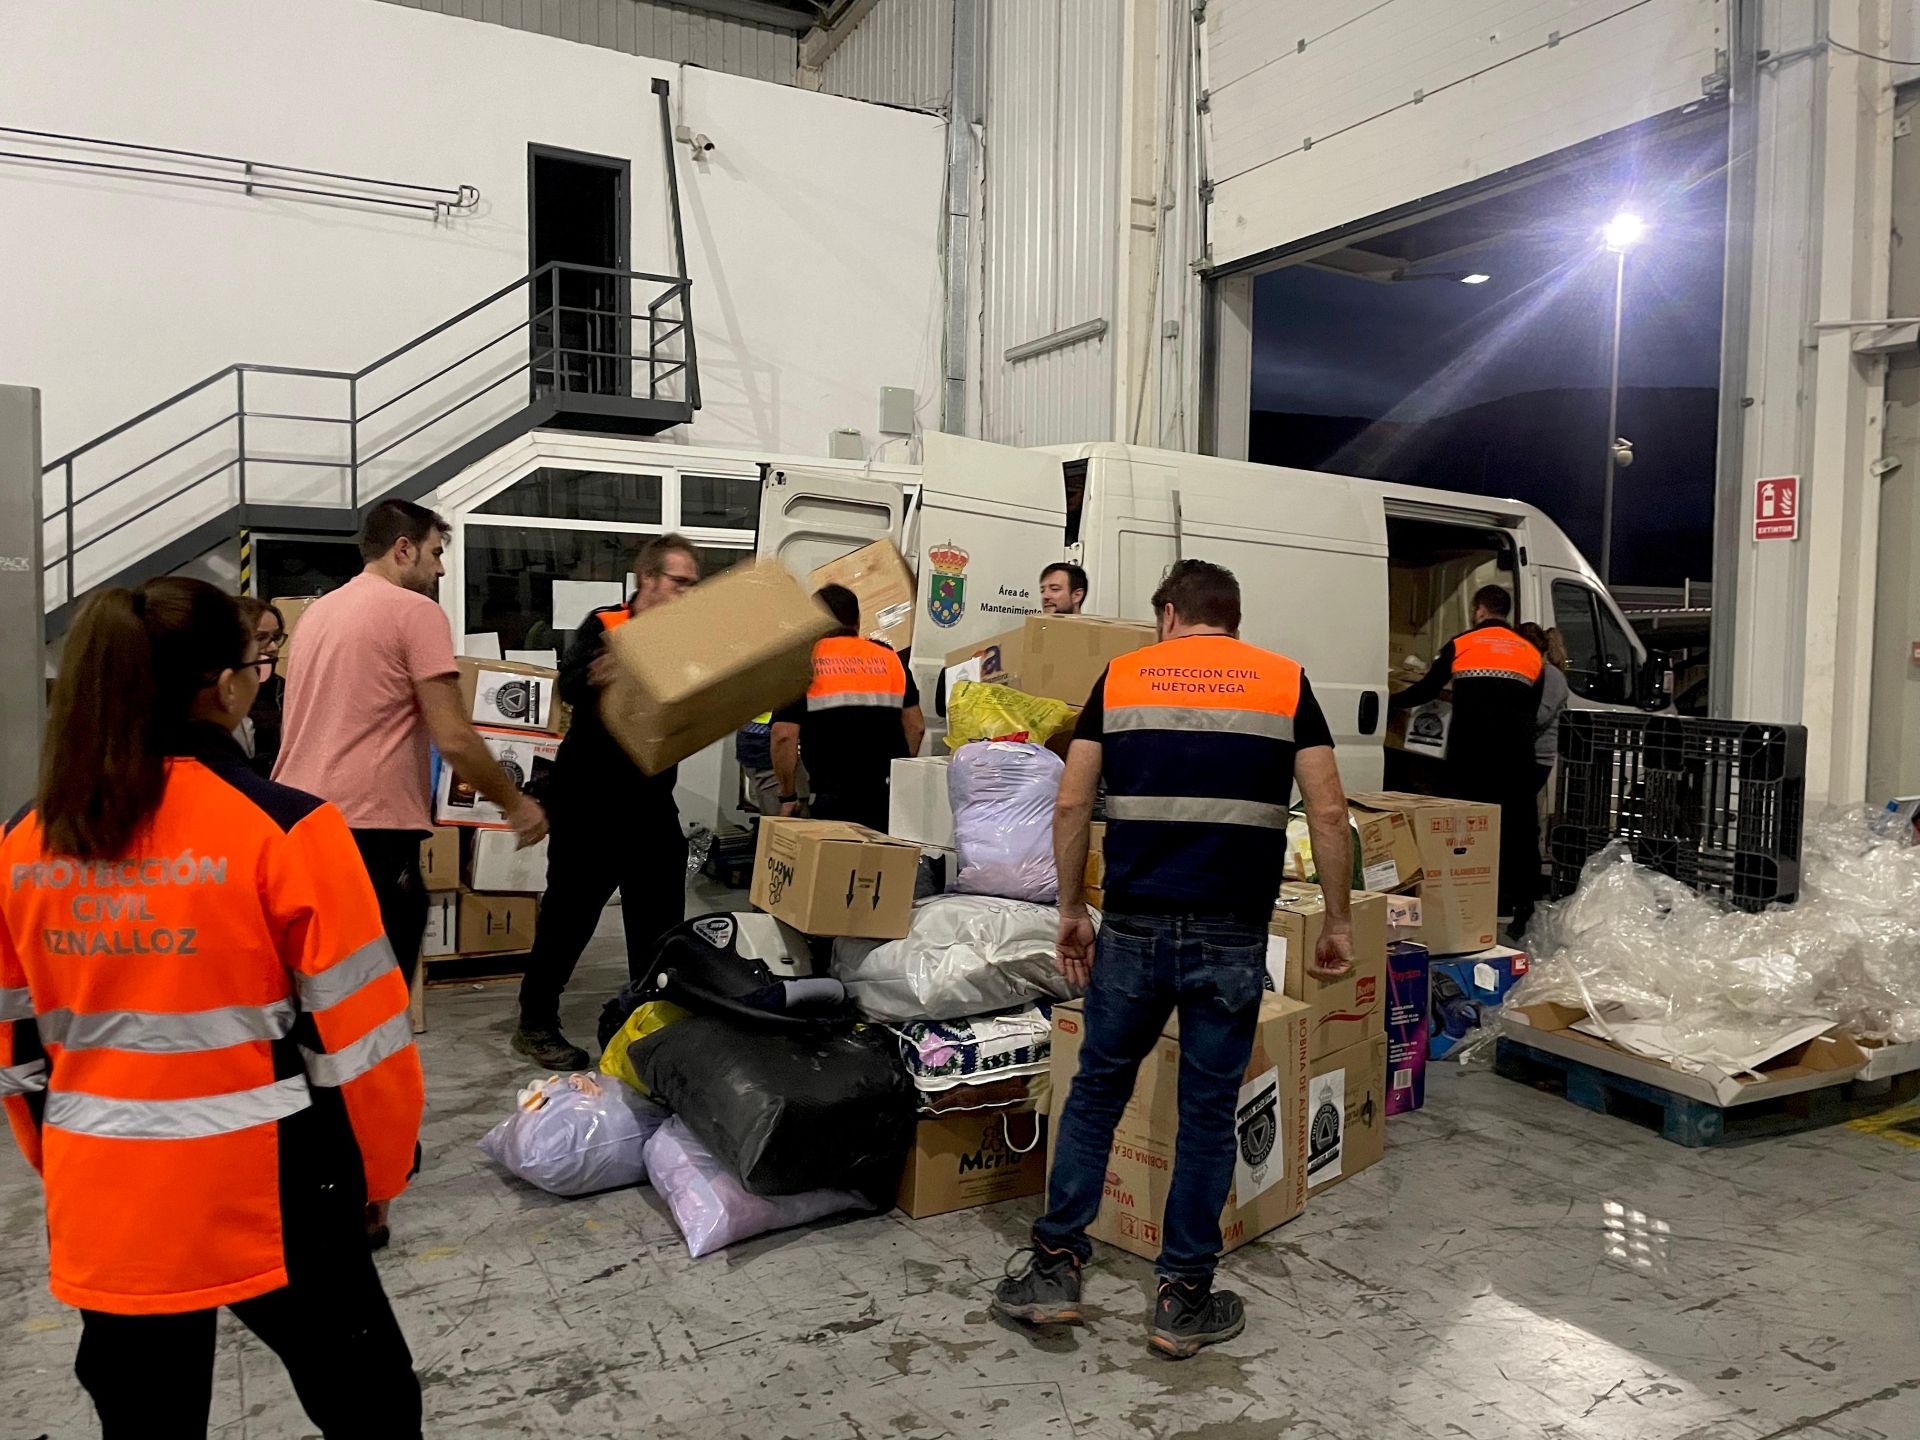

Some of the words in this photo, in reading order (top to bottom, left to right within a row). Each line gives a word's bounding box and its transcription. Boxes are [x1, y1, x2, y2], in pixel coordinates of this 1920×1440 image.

[998, 585, 1018, 597] Área
[1019, 588, 1030, 598] de
[980, 603, 1043, 616] Mantenimiento
[1139, 668, 1223, 679] PROTECCION
[1226, 669, 1261, 680] CIVIL
[1151, 682, 1206, 693] HUETOR
[1208, 683, 1245, 693] VEGA
[11, 848, 228, 891] PROTECCIÓN
[72, 893, 156, 922] CIVIL
[1299, 1017, 1307, 1071] BOBINA
[1299, 1076, 1307, 1096] DE
[1298, 1098, 1307, 1162] ALAMBRE
[959, 1148, 1021, 1175] Merlo
[1121, 1149, 1133, 1160] DE
[1135, 1153, 1169, 1171] BOBINA
[1295, 1164, 1307, 1210] DOBLE
